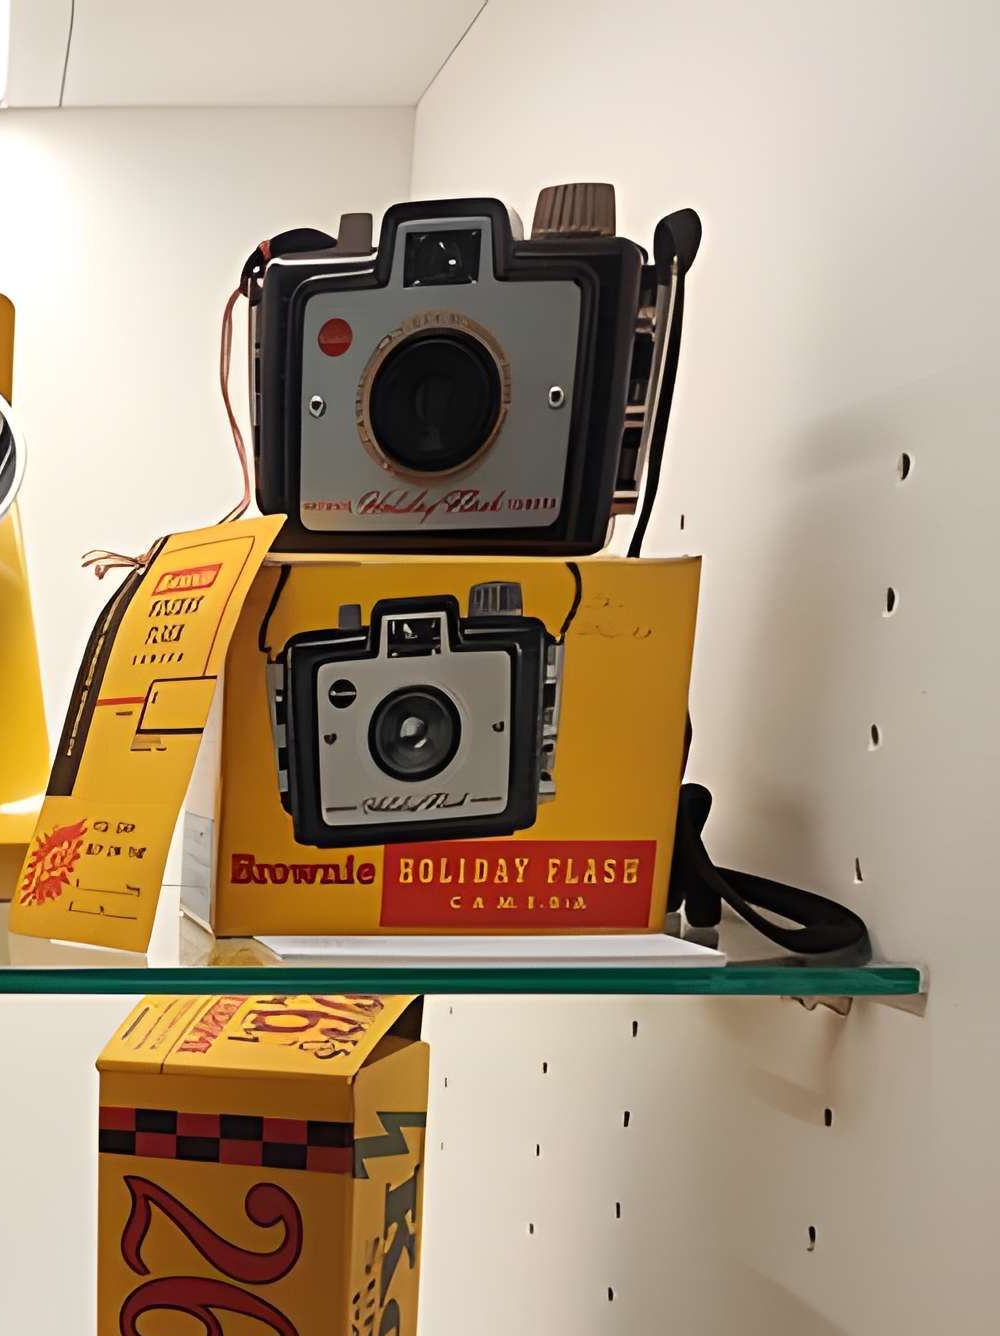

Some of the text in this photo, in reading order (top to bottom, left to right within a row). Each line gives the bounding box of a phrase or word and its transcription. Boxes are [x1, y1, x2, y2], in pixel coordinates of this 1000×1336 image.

[230, 853, 641, 885] Brownie HOLIDAY FLASH
